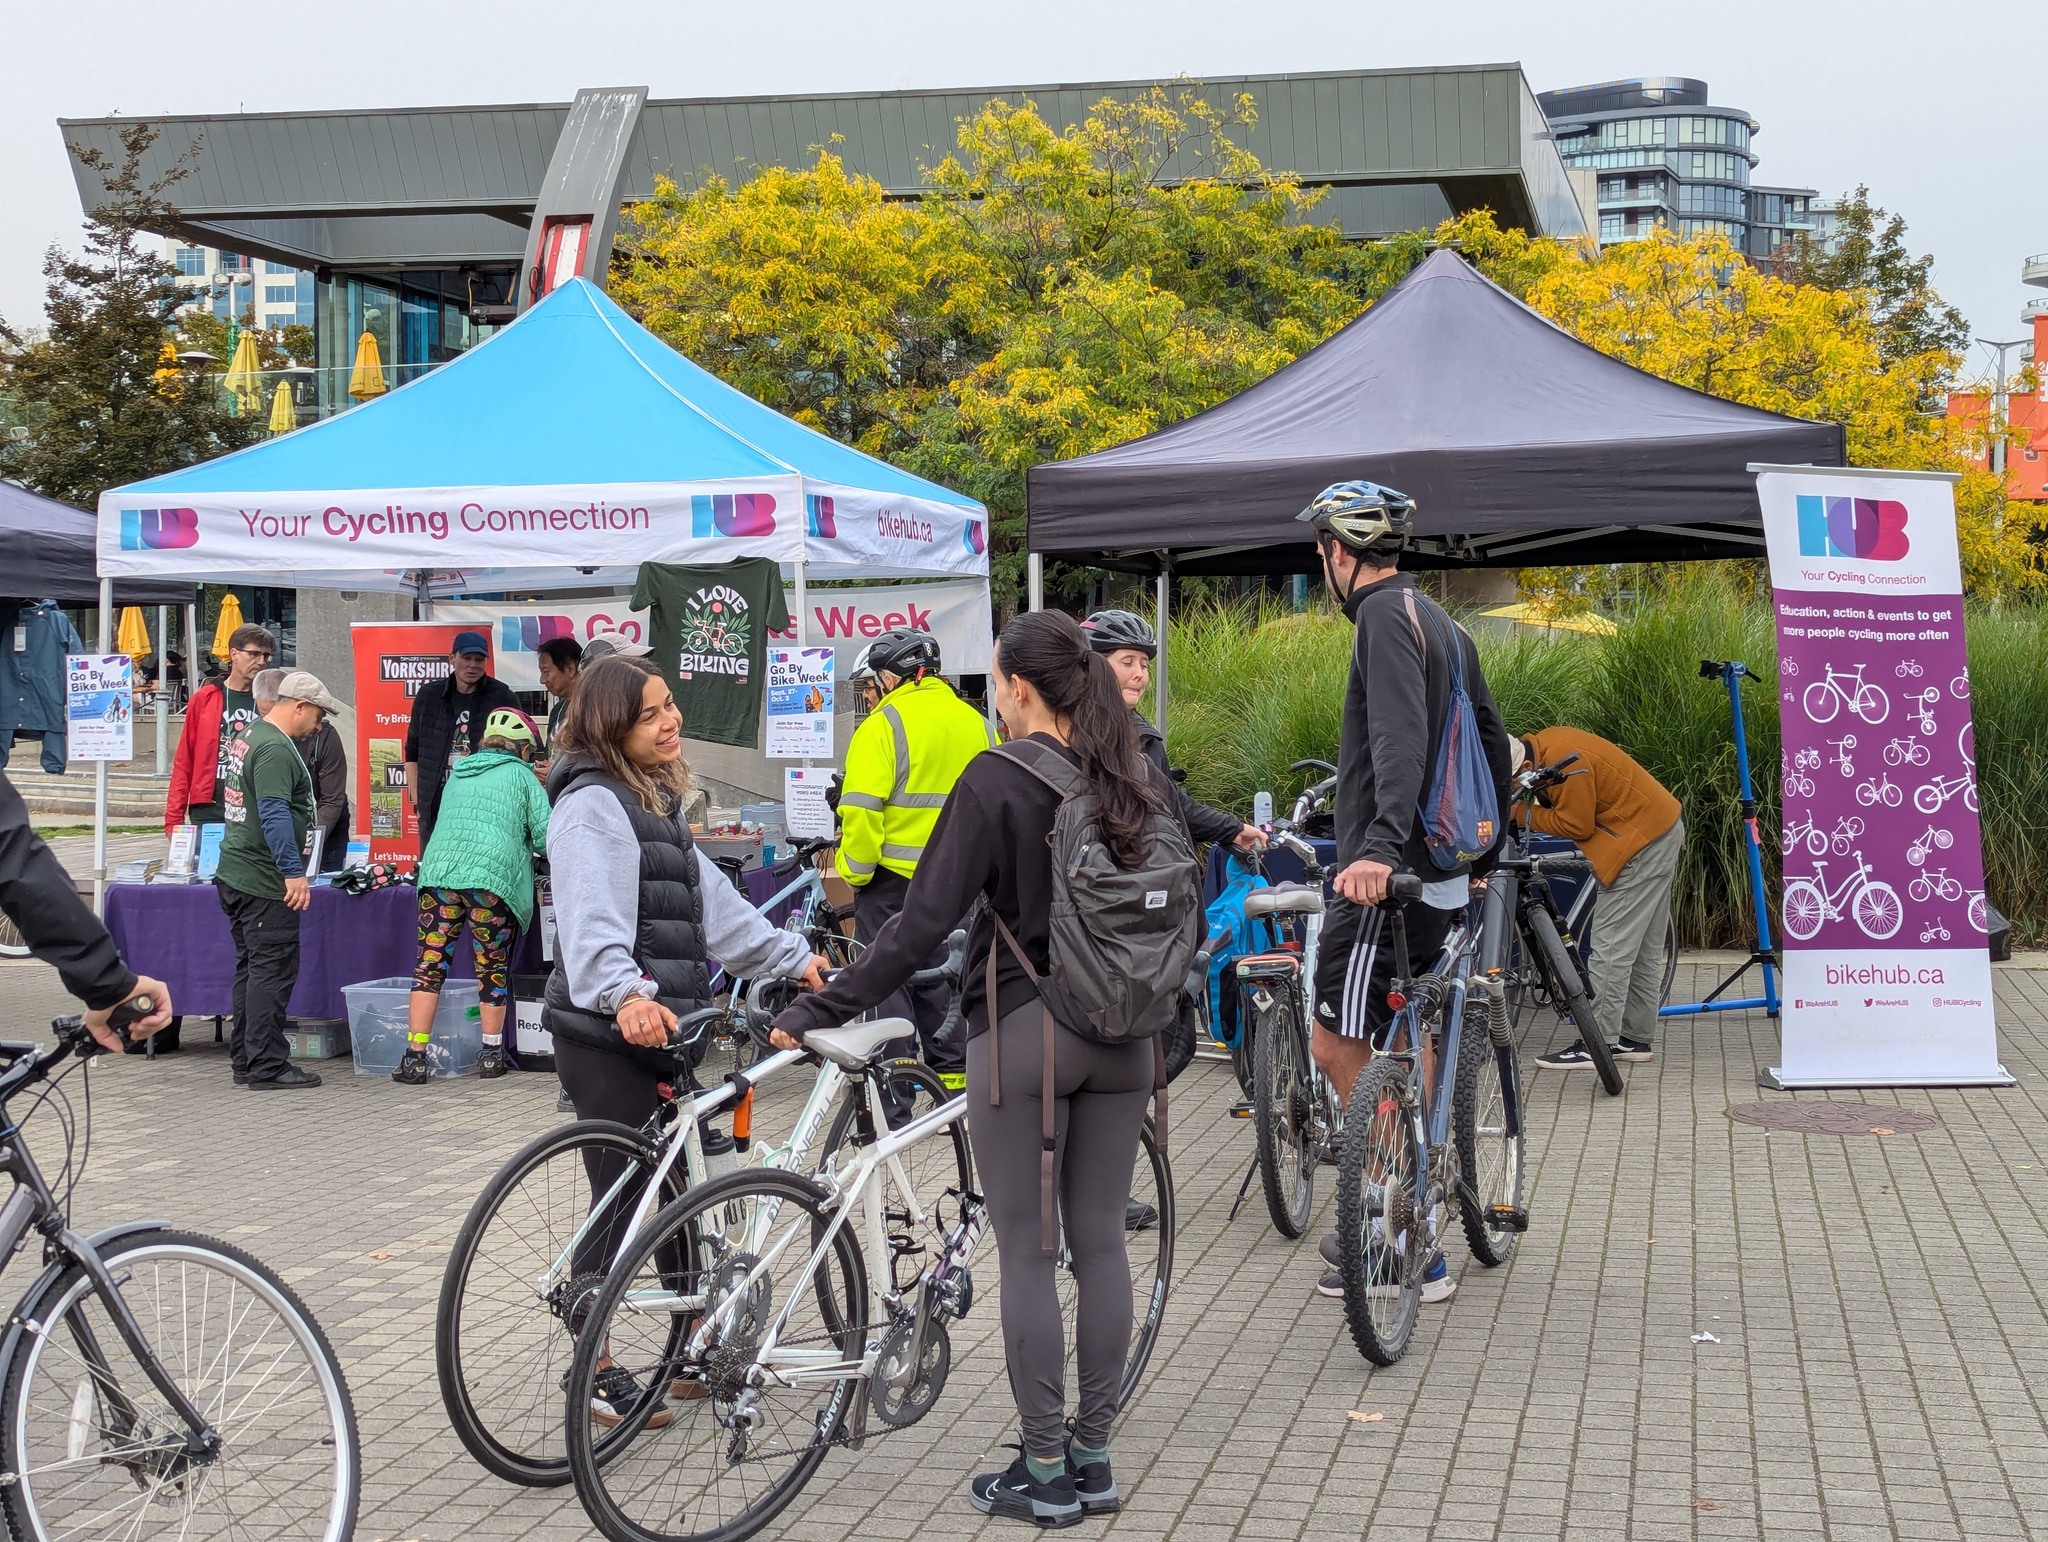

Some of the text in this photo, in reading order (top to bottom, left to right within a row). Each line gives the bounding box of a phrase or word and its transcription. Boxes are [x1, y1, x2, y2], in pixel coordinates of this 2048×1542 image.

[239, 501, 649, 541] Your Cycling Connection
[877, 509, 933, 543] bikehub.ca
[1801, 570, 1926, 585] Your Cycling Connection
[687, 585, 748, 614] I LOVE
[814, 603, 932, 638] Week
[1780, 604, 1952, 622] Education, action & events to get
[1783, 627, 1949, 642] more people cycling more often
[383, 659, 455, 679] YORKSHIR
[680, 653, 749, 676] BIKING
[770, 664, 803, 675] Go By
[70, 670, 104, 681] Go By
[771, 673, 829, 685] Bike Week
[71, 678, 129, 692] Bike Week
[376, 714, 390, 725] Try
[374, 852, 392, 861] Let's
[393, 851, 411, 861] have
[1826, 964, 1945, 985] bikehub.ca
[820, 1384, 844, 1437] GIANT
